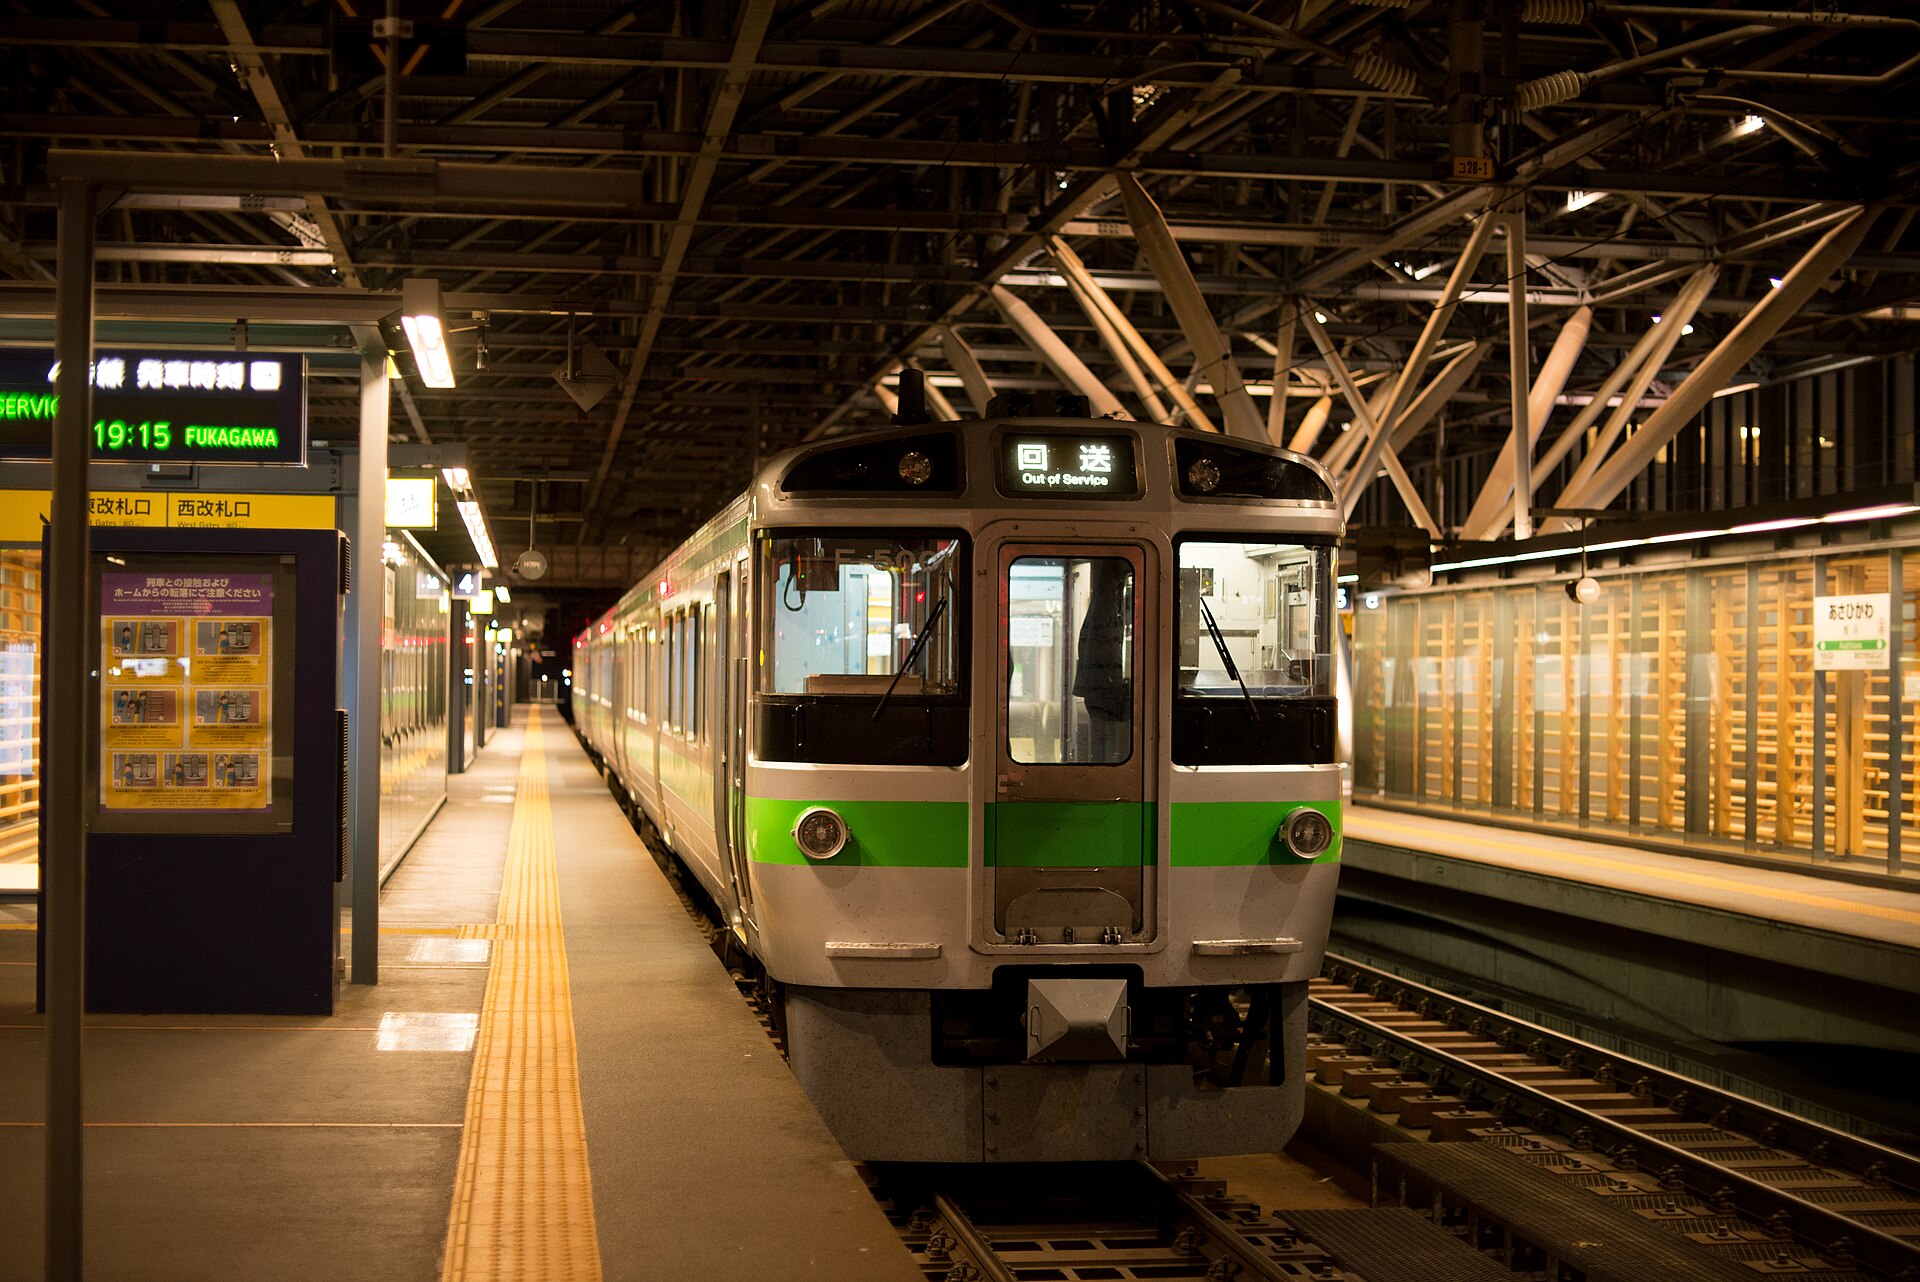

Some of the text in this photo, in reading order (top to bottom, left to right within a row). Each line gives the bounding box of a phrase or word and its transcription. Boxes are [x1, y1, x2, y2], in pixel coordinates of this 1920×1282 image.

[93, 420, 278, 449] 19:15 FUKAGAWA
[1022, 472, 1109, 486] Out of Service
[177, 499, 250, 517] 西改札口
[458, 573, 475, 594] 4
[1829, 603, 1874, 620] あさひかわ
